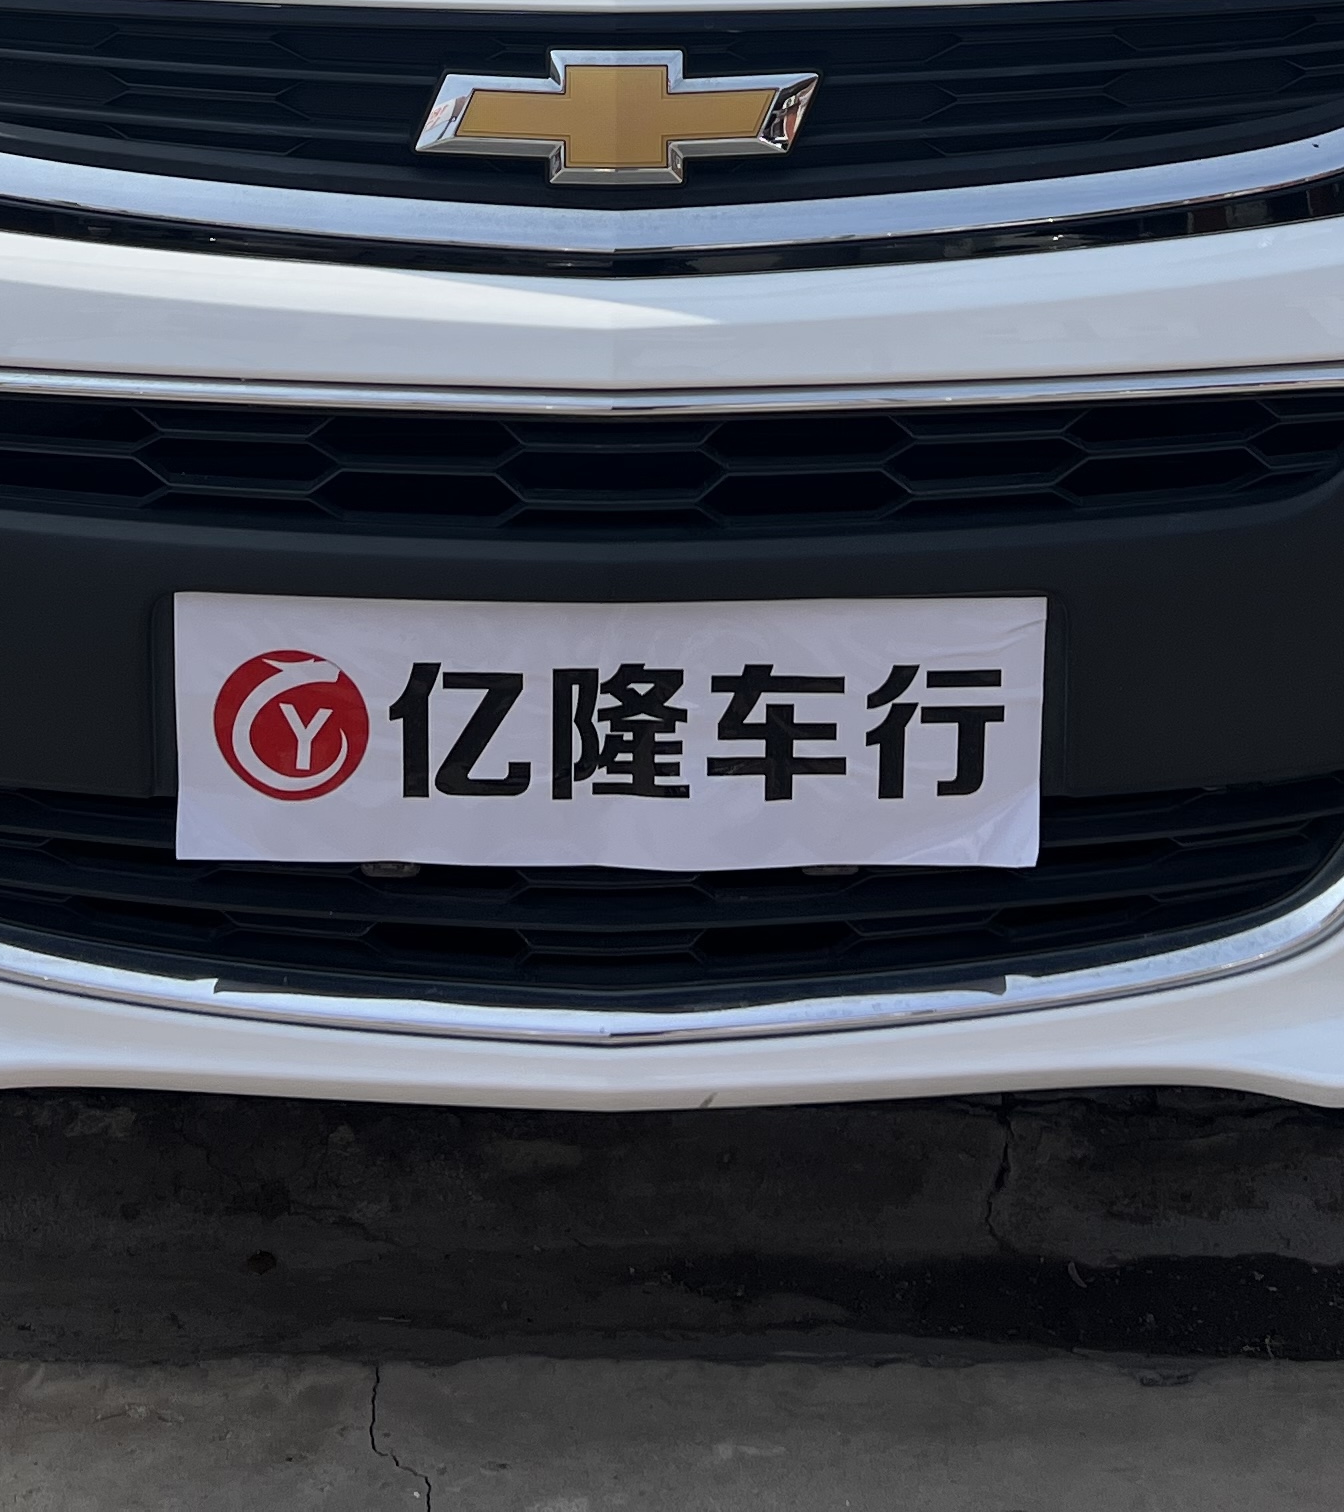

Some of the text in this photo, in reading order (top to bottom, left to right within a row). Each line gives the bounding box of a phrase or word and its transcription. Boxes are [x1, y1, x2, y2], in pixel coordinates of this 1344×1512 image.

[279, 661, 1005, 802] Y 亿隆车行
